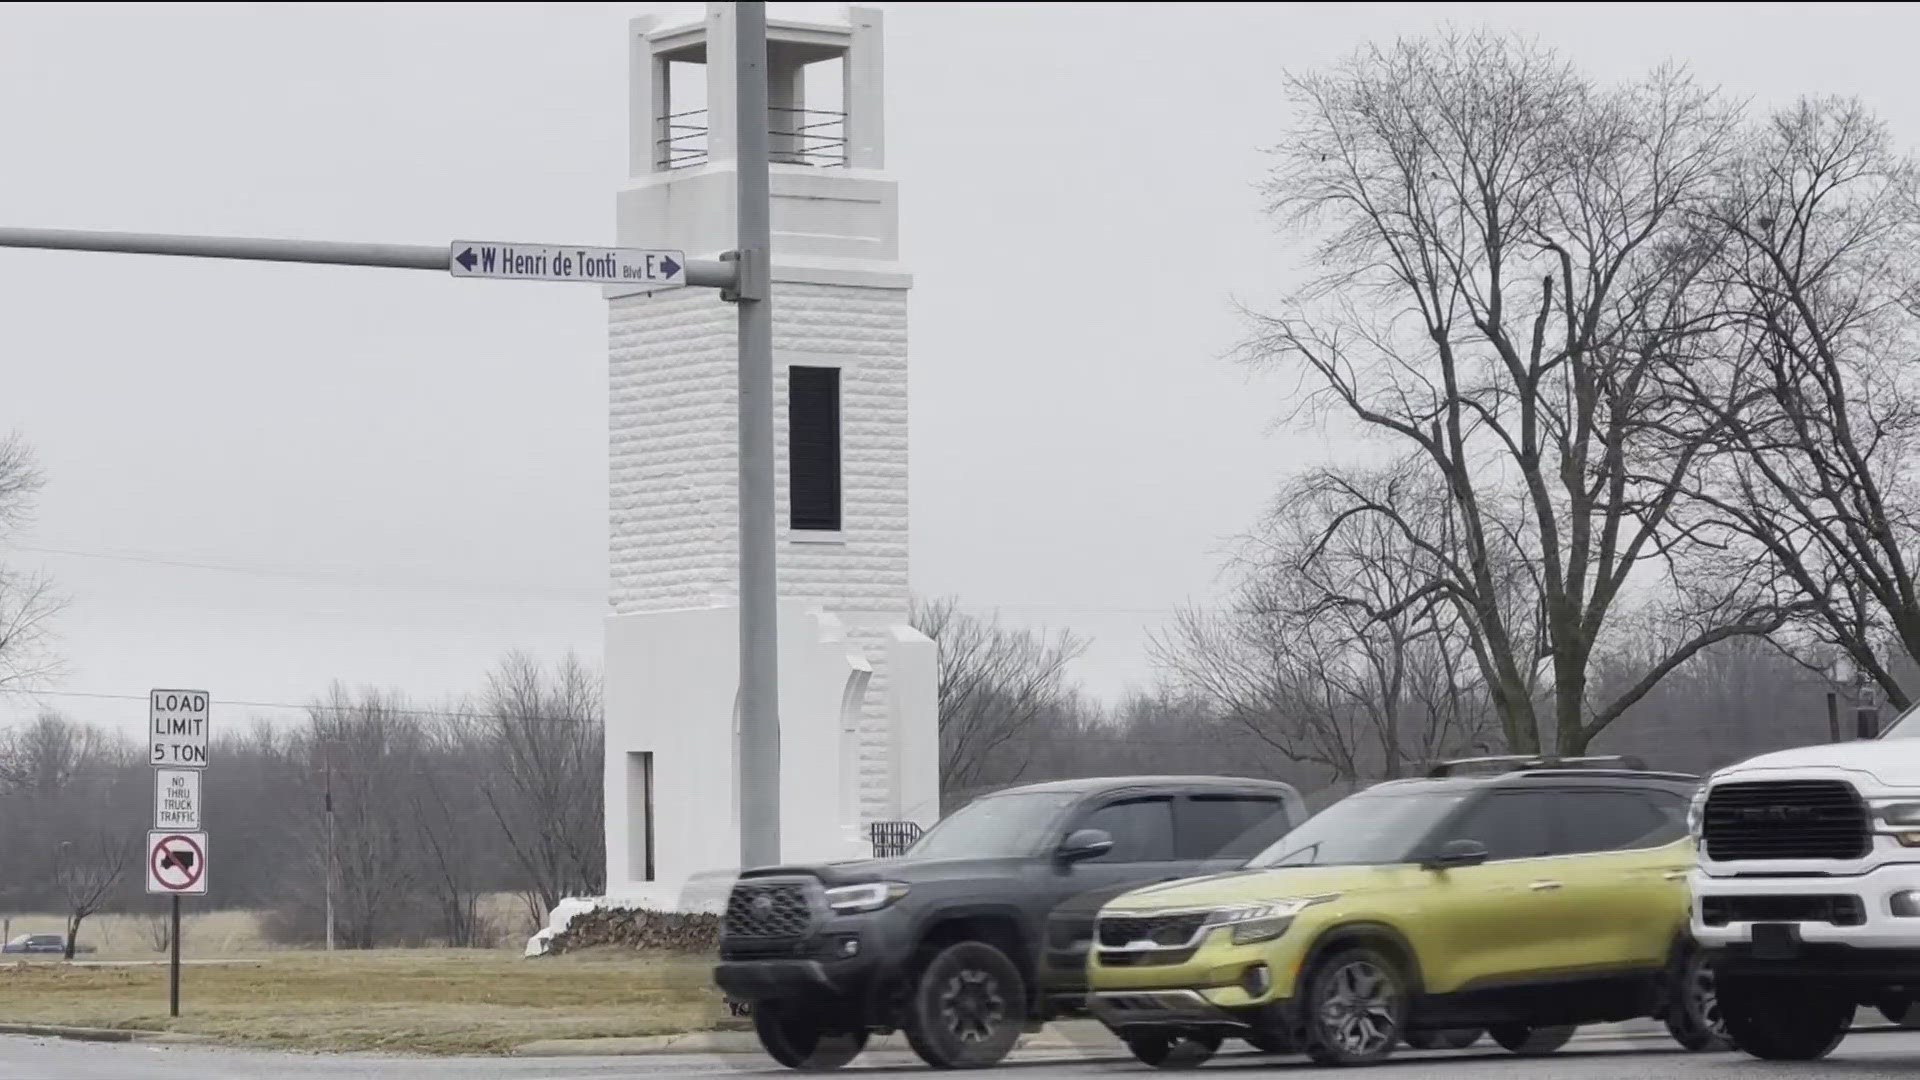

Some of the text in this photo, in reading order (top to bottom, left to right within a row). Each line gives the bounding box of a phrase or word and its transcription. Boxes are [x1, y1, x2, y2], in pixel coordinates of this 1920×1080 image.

[481, 247, 656, 279] W Henri de Tonti Blvd E
[155, 694, 205, 712] LOAD
[155, 718, 203, 736] LIMIT
[154, 743, 206, 762] 5 TON
[172, 777, 184, 787] NO
[167, 787, 190, 799] THRU
[164, 799, 192, 810] TRUCK
[160, 811, 195, 822] TRAFFIC
